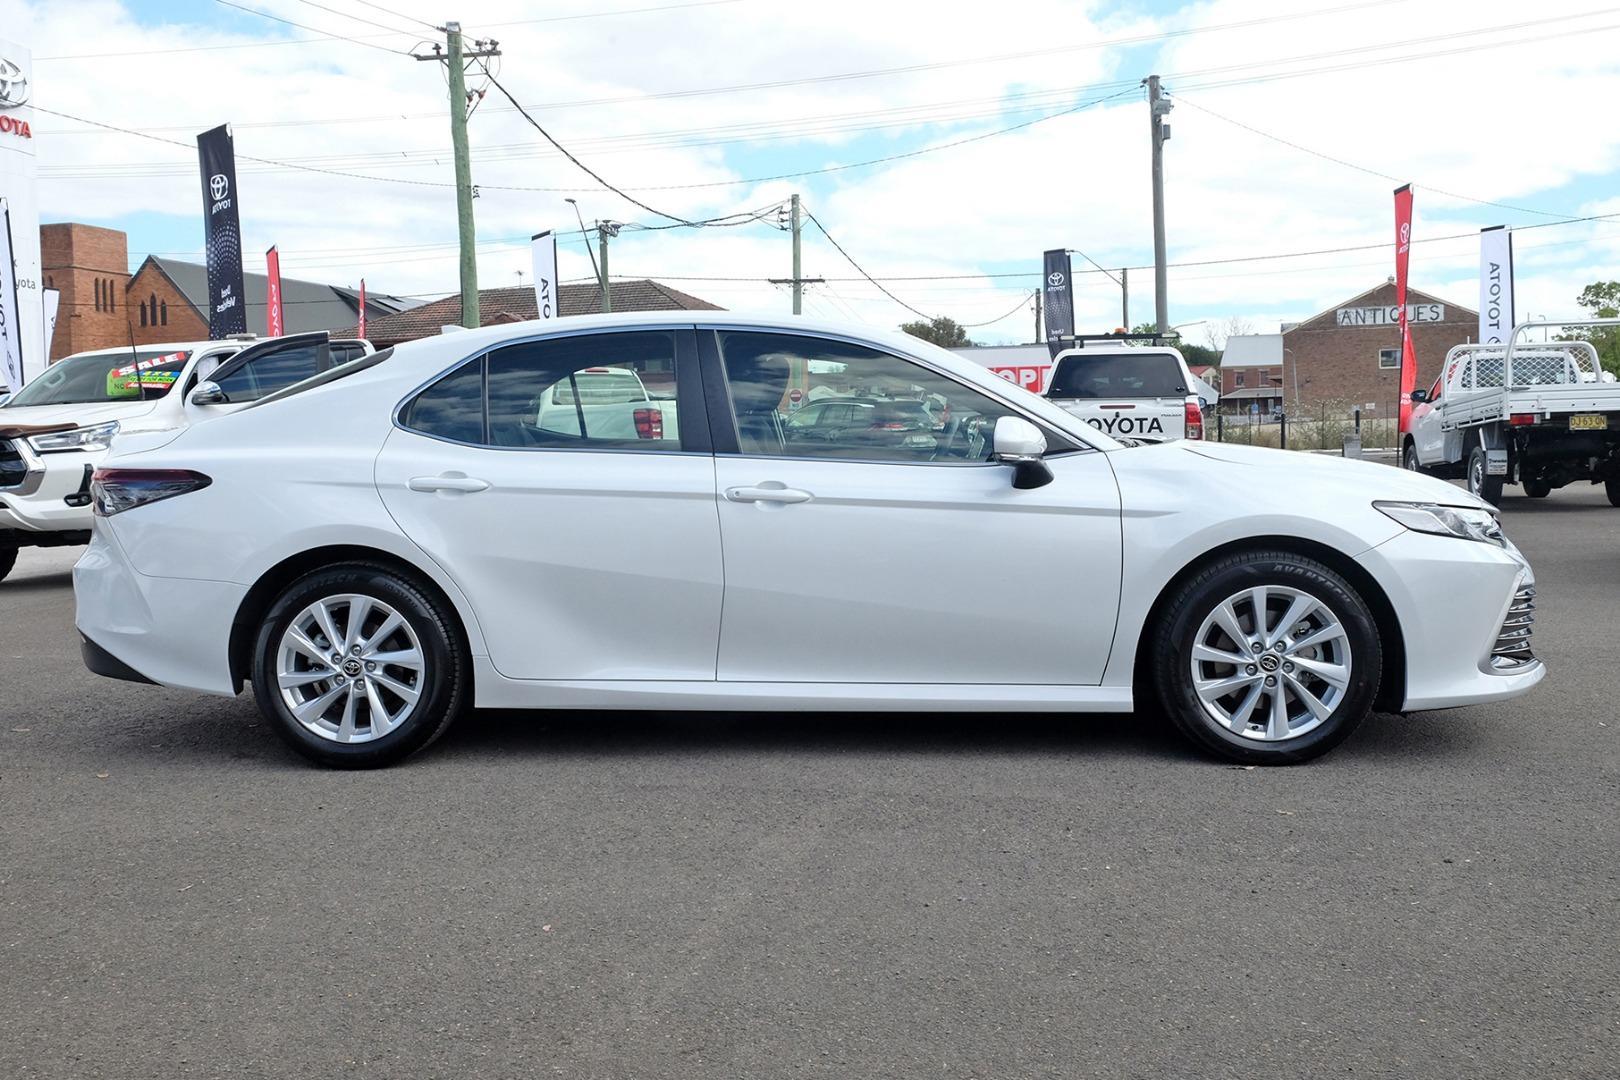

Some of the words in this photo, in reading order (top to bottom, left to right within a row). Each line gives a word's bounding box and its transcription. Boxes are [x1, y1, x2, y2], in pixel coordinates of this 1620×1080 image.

[0, 115, 32, 138] OTA
[15, 278, 36, 291] yota
[1341, 305, 1440, 325] ANTIQUES
[118, 352, 179, 376] SALE
[1083, 418, 1164, 433] OYOTA
